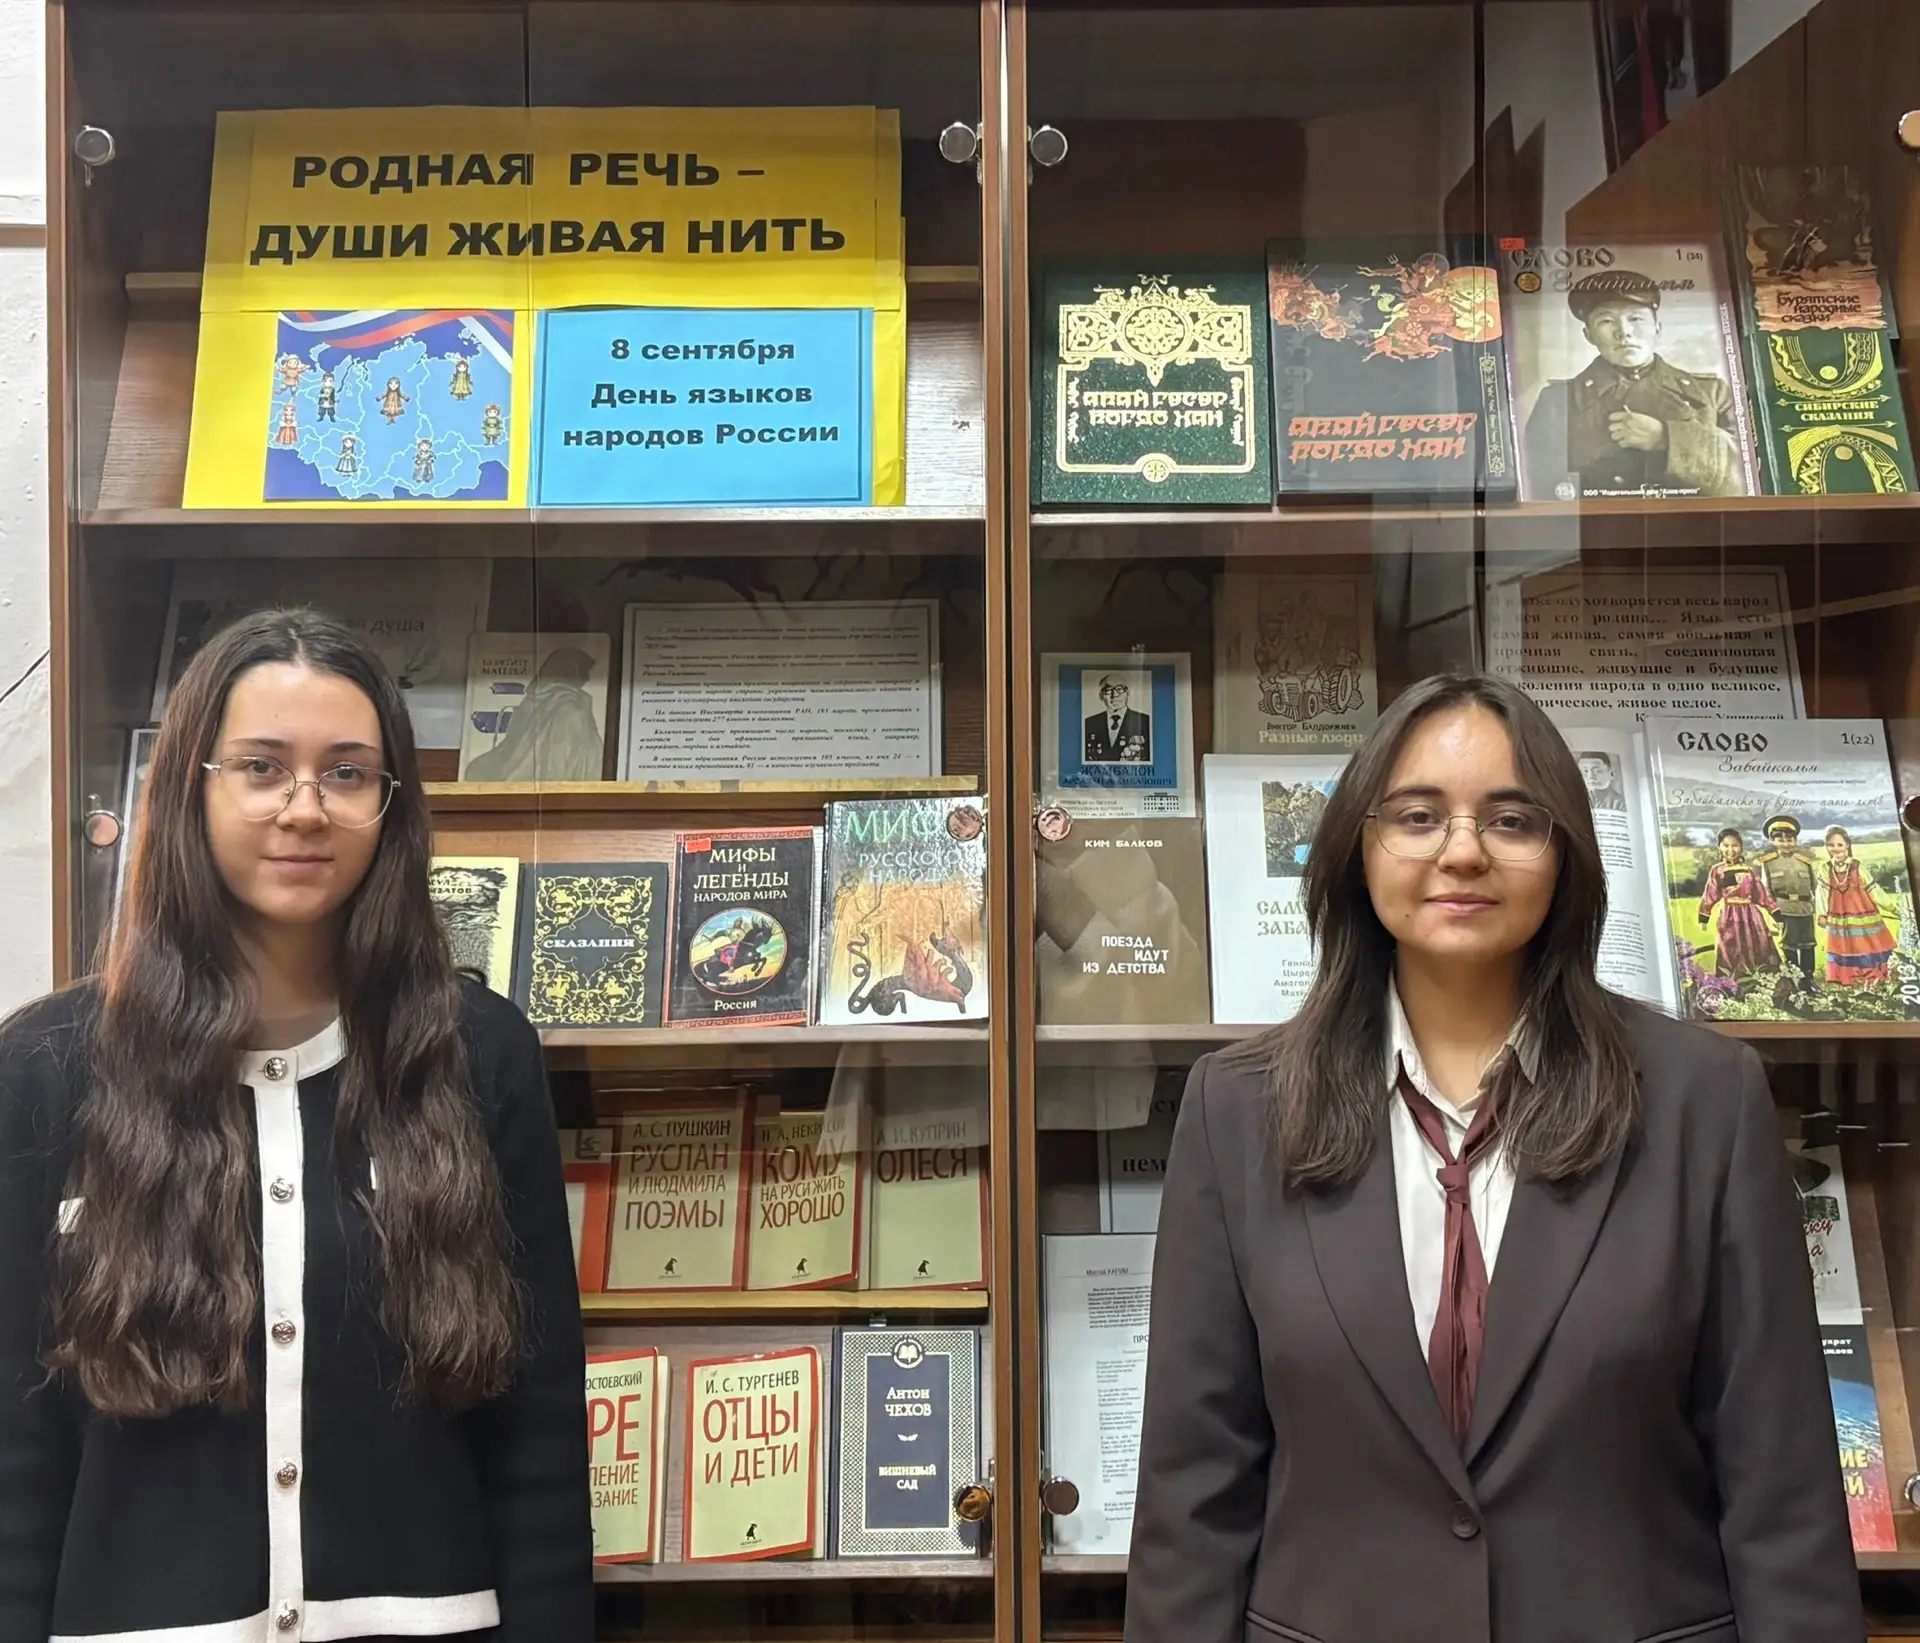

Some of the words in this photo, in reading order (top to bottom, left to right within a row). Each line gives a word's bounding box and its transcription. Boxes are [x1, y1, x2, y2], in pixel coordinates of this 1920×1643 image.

[293, 153, 532, 194] РОДНАЯ
[569, 152, 719, 186] РЕЧЬ
[250, 222, 428, 265] ДУШИ
[447, 219, 665, 257] ЖИВАЯ
[687, 218, 846, 254] НИТЬ
[1776, 290, 1861, 309] Бурятские
[1780, 311, 1833, 324] сказки
[1793, 301, 1862, 317] народные
[610, 338, 629, 360] 8
[641, 338, 795, 366] сентября
[590, 381, 678, 409] День
[687, 384, 813, 404] языков
[1794, 400, 1880, 412] СИБИРСКИЕ
[1800, 410, 1876, 422] СКАЗАНИЯ
[562, 424, 704, 452] народов
[715, 421, 841, 445] России
[370, 618, 424, 635] душа
[1596, 662, 1673, 677] живущие
[1685, 664, 1695, 674] и
[1708, 660, 1779, 677] будущие
[1518, 681, 1583, 692] коления
[1590, 681, 1646, 694] народа
[1651, 682, 1661, 691] в
[1667, 681, 1704, 694] одно
[1710, 680, 1782, 693] великое,
[1534, 699, 1613, 712] рическое,
[1616, 698, 1668, 710] живое
[1671, 698, 1722, 711] целое.
[1258, 730, 1318, 744] Разные
[1677, 731, 1769, 753] СЛОВО
[1840, 732, 1876, 747] 1(22)
[1718, 755, 1821, 774] Забайкалья
[843, 807, 943, 844] МИФ
[1084, 839, 1111, 849] КИМ
[1115, 839, 1164, 849] БАЛКОВ
[709, 847, 777, 864] МИФЫ
[859, 850, 961, 869] РУССКОГО
[693, 872, 790, 890] ЛЕГЕНДЫ
[869, 867, 952, 884] НАРОДА
[693, 891, 751, 903] НАРОДОВ
[753, 889, 789, 901] МИРА
[1256, 900, 1306, 916] САМ
[1257, 920, 1310, 937] ЗАБА
[542, 938, 636, 949] СКАЗАНИЯ
[1100, 935, 1154, 949] ПОЕЗДА
[1133, 949, 1170, 962] ИДУТ
[1282, 959, 1311, 968] Генна
[1081, 962, 1101, 973] ИЗ
[1106, 962, 1167, 975] ДЕТСТВА
[714, 999, 758, 1012] Россия
[632, 1123, 646, 1138] А.
[651, 1122, 664, 1137] С.
[667, 1119, 732, 1138] ПУШКИН
[909, 1120, 968, 1143] КУПРИН
[630, 1142, 729, 1174] РУСЛАН
[761, 1138, 847, 1186] КОМУ
[876, 1144, 969, 1184] ОЛЕСЯ
[628, 1179, 640, 1195] И
[642, 1174, 727, 1197] ЛЮДМИЛА
[760, 1187, 779, 1203] НА
[781, 1180, 812, 1201] РУСИ
[813, 1175, 846, 1197] ЖИТЬ
[625, 1199, 726, 1231] ПОЭМЫ
[760, 1191, 846, 1230] ХОРОШО
[1133, 1334, 1149, 1344] ПРО
[585, 1370, 642, 1391] ОСТОЕВСКИЙ
[705, 1379, 719, 1395] И.
[722, 1377, 734, 1393] С.
[738, 1369, 800, 1392] ТУРГЕНЕВ
[703, 1390, 800, 1446] ОТЦЫ
[884, 1403, 932, 1417] ЧЕХОВ
[588, 1393, 642, 1464] РЕ
[705, 1451, 722, 1485] И
[730, 1441, 799, 1489] ДЕТИ
[878, 1463, 937, 1477] ВИШНЕВЫЙ
[590, 1462, 640, 1488] ЛЕНИЕ
[896, 1479, 919, 1491] САД
[590, 1487, 639, 1509] ЗАНИЕ
